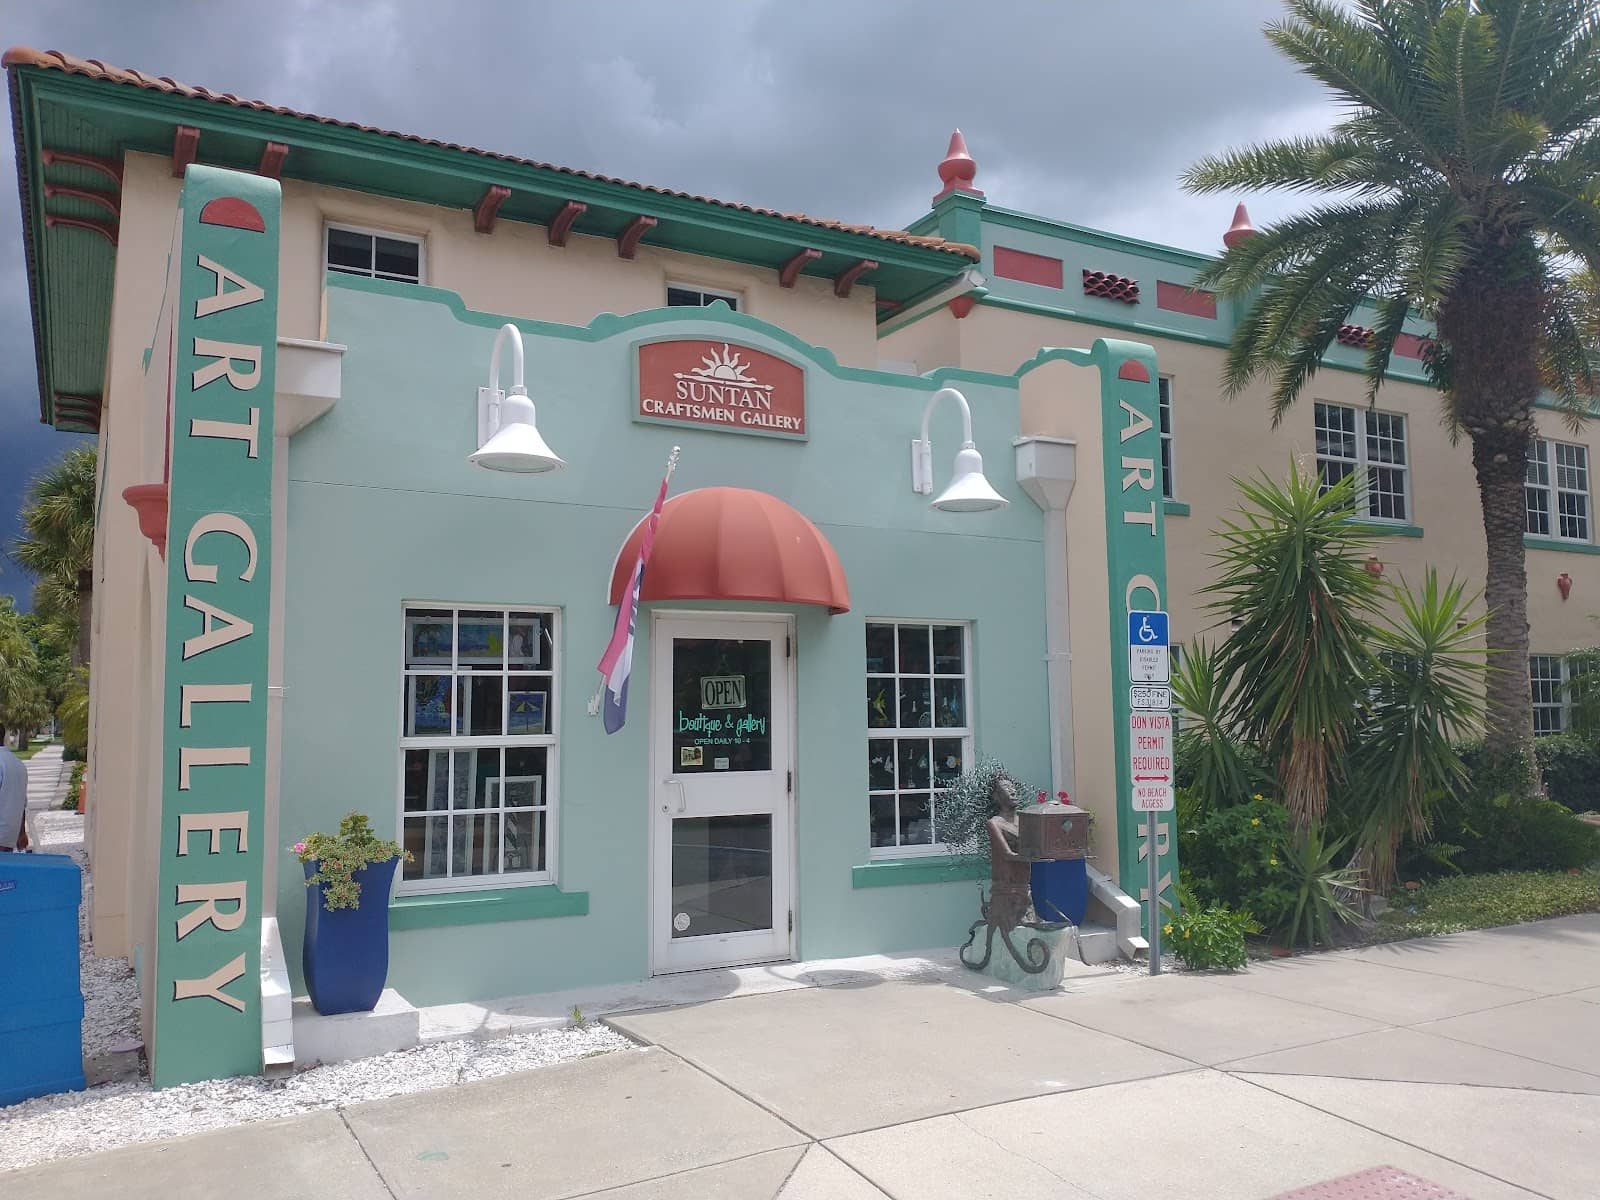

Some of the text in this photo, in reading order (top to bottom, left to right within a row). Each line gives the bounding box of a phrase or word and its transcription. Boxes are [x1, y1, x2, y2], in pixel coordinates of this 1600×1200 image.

[676, 380, 771, 410] SUNTAN
[642, 398, 802, 430] CRAFTSMEN GALLERY
[1119, 399, 1157, 536] ART
[173, 254, 265, 1013] ART GALLERY
[705, 680, 741, 705] OPEN
[1133, 689, 1168, 698] $250 FINE
[679, 710, 766, 738] boutique & gallery
[1132, 716, 1170, 729] DON VISTA
[1138, 737, 1165, 750] PERMIT
[1133, 757, 1170, 770] REQUIRED
[1137, 788, 1167, 797] NO BEACH
[1141, 799, 1164, 809] ACCESS
